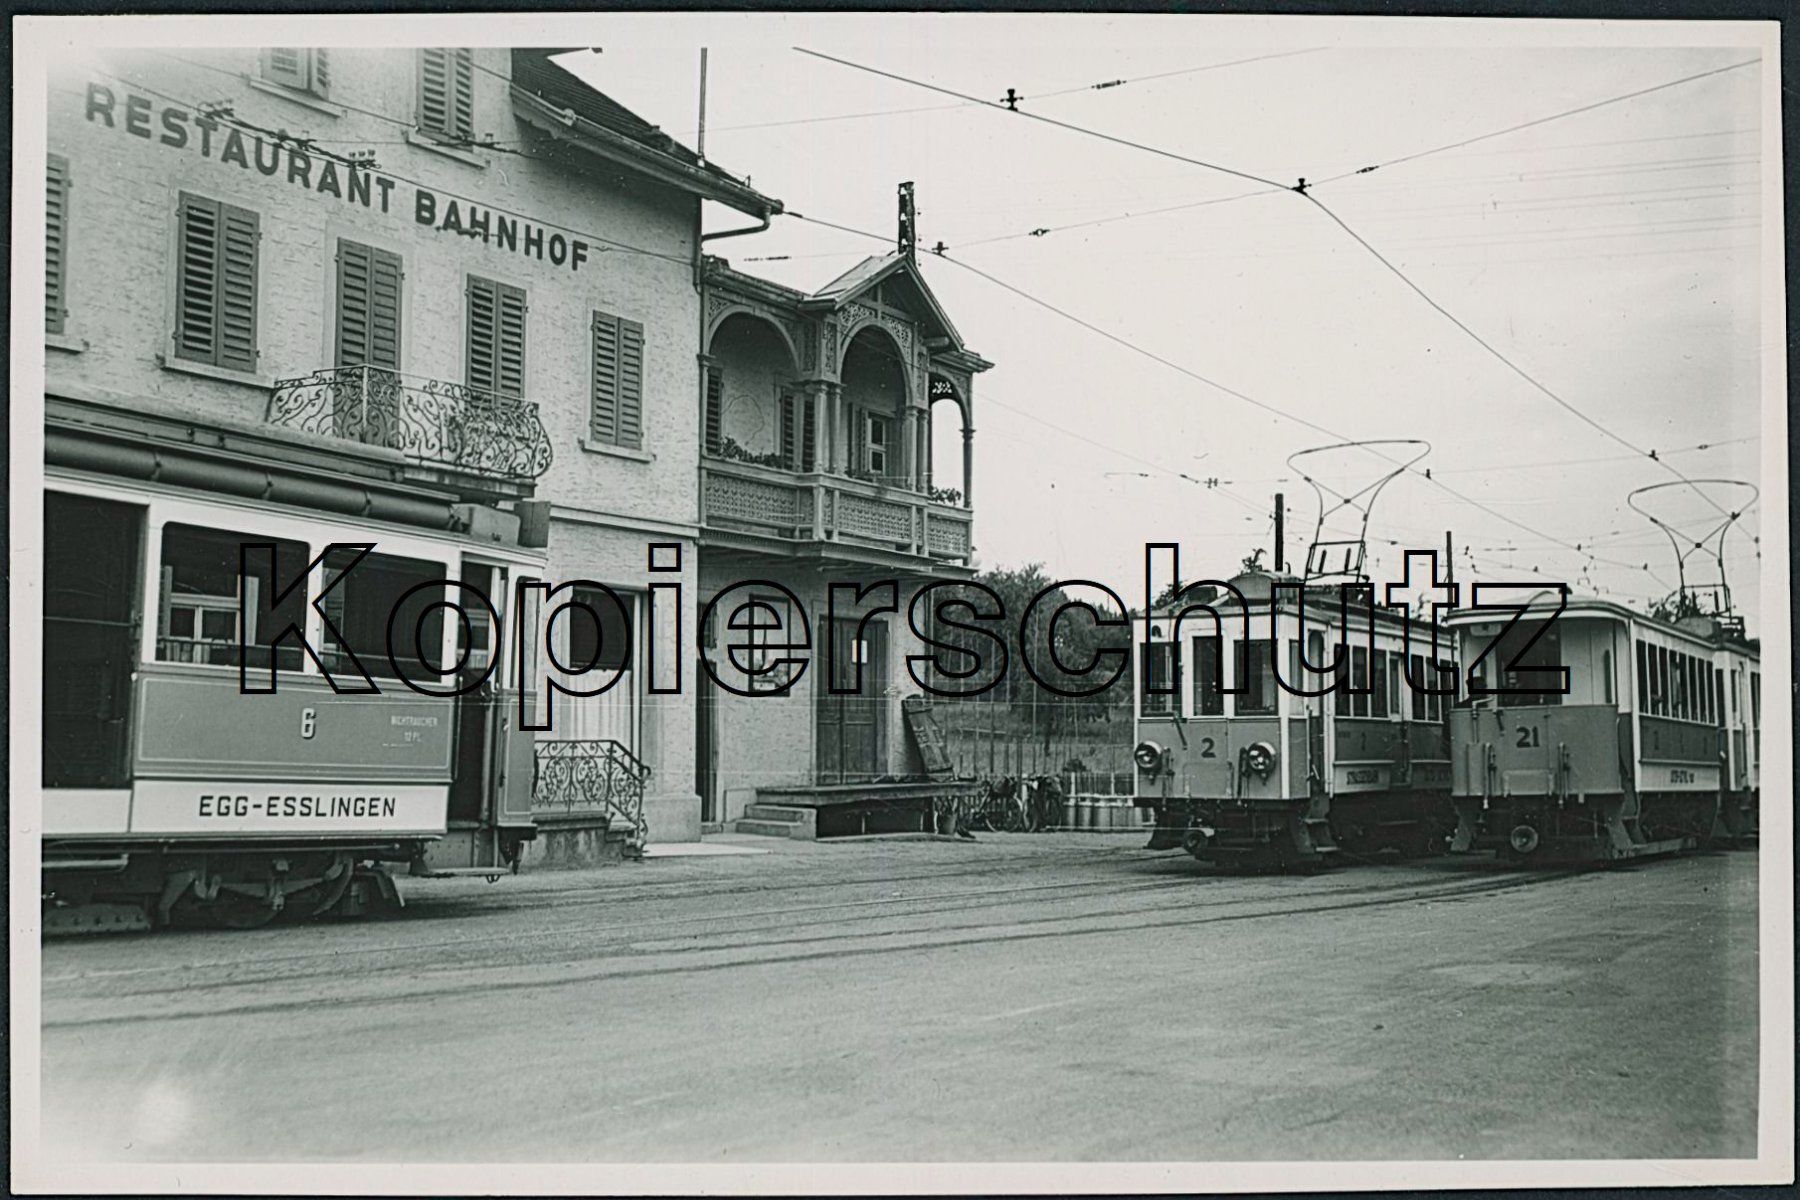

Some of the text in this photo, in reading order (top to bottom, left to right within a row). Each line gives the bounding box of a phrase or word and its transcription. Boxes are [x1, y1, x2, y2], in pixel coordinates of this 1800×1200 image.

[87, 85, 588, 271] RESTAURANT BAHNHOF
[301, 707, 316, 739] 6
[1201, 737, 1216, 758] 2
[1516, 726, 1540, 748] 21
[200, 795, 396, 817] EGG-ESSLINGEN
